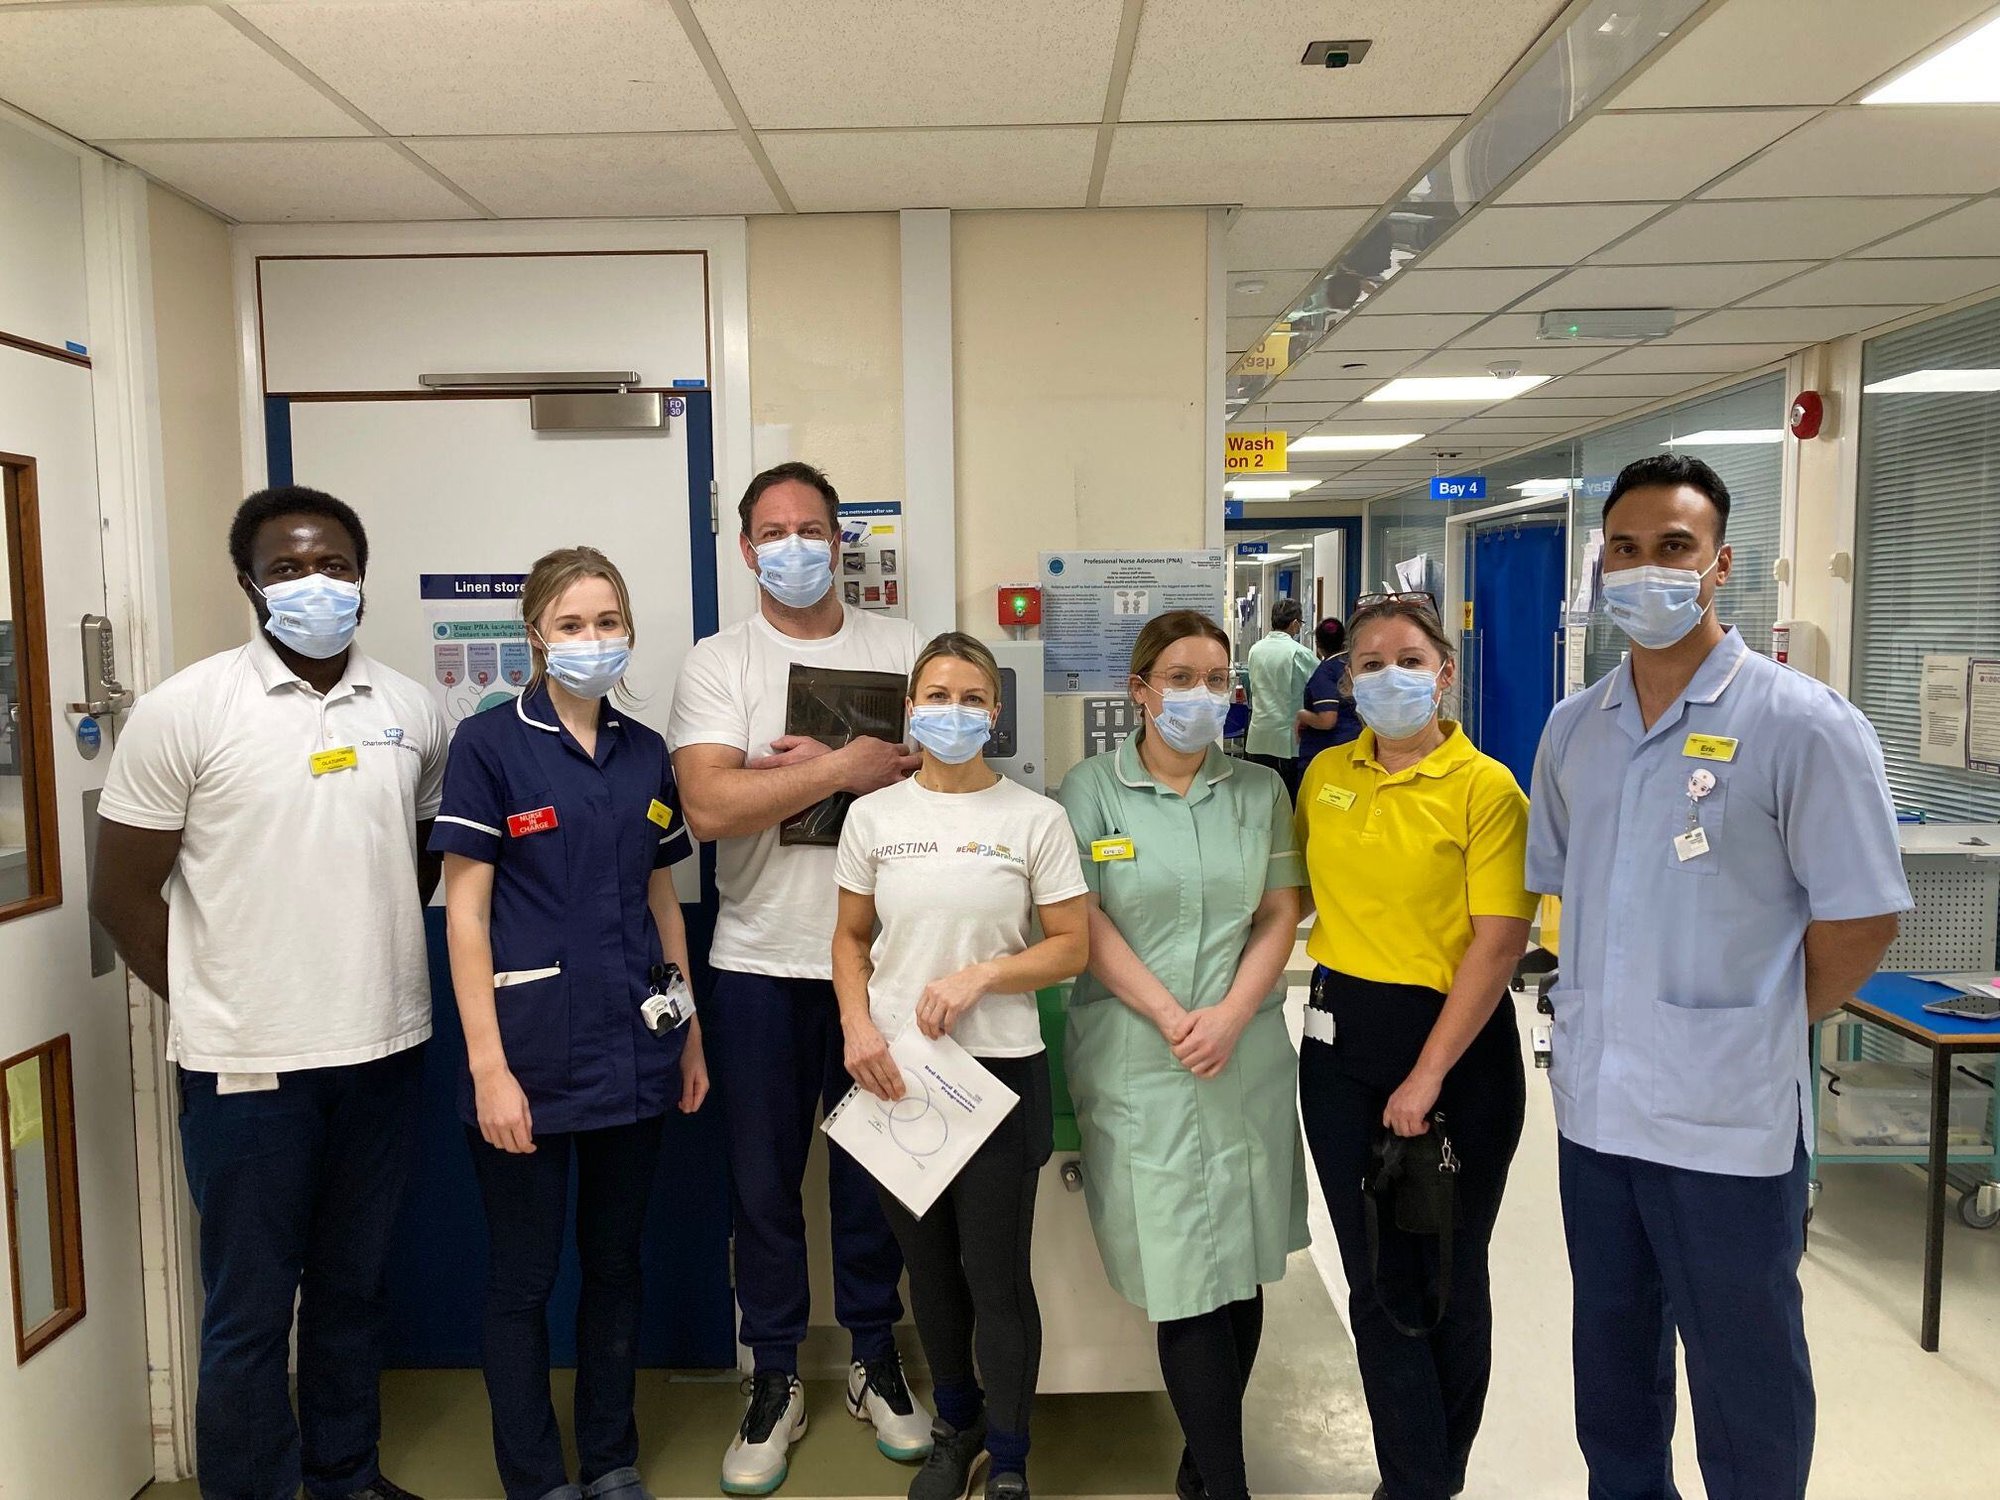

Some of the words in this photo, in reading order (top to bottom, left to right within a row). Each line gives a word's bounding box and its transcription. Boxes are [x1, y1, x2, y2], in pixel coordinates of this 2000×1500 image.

[670, 400, 681, 408] FD
[670, 408, 681, 416] 30
[1227, 437, 1274, 451] Wash
[1254, 454, 1264, 468] 2
[1439, 482, 1465, 497] Bay
[1469, 482, 1478, 493] 4
[1242, 545, 1257, 553] Bay
[1166, 557, 1183, 565] (PNA)
[455, 581, 490, 593] Linen
[1700, 745, 1716, 753] Eric
[519, 811, 543, 822] NURSE
[528, 817, 537, 825] IN
[519, 821, 550, 833] CHARGE
[871, 842, 938, 857] CHRISTINA
